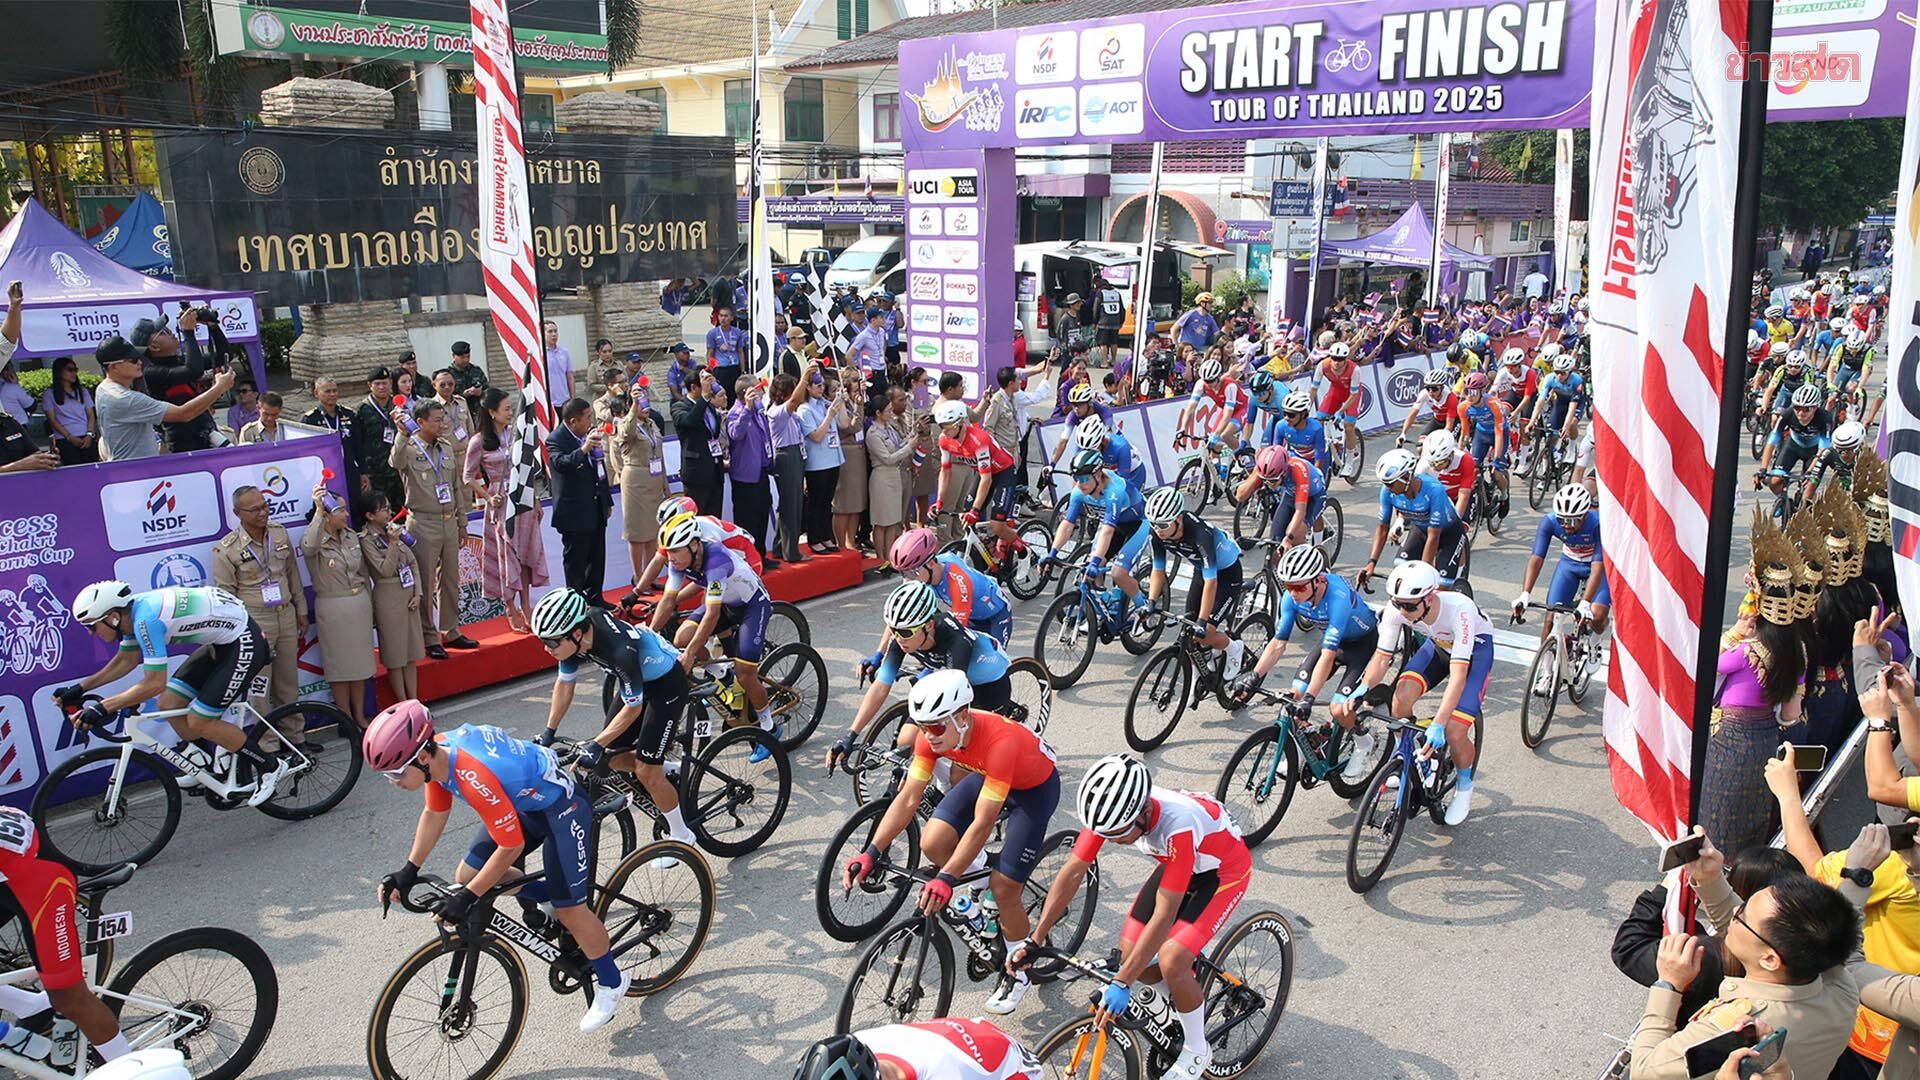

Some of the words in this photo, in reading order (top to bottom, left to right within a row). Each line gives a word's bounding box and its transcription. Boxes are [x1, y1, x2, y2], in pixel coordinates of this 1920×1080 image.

[1179, 20, 1324, 93] START
[1377, 0, 1567, 81] FINISH
[1032, 62, 1057, 74] NSDF
[1101, 58, 1125, 71] SAT
[1109, 100, 1138, 115] AOT
[1211, 97, 1265, 121] TOUR
[1273, 96, 1300, 118] OF
[1306, 89, 1430, 116] THAILAND
[1433, 85, 1503, 113] 2025
[913, 181, 938, 194] UCI
[62, 312, 120, 328] Timing
[1395, 374, 1421, 402] Ford
[142, 515, 187, 533] NSDF
[40, 548, 74, 564] Cup
[178, 619, 238, 633] UZBEKISTAN
[252, 676, 267, 697] 142
[150, 743, 200, 777] AURUM
[1212, 890, 1245, 933] INDONESIA
[55, 904, 72, 961] INDONESIA
[99, 918, 128, 939] 154
[490, 912, 561, 962] WIAWIS
[1263, 919, 1290, 945] HYPER
